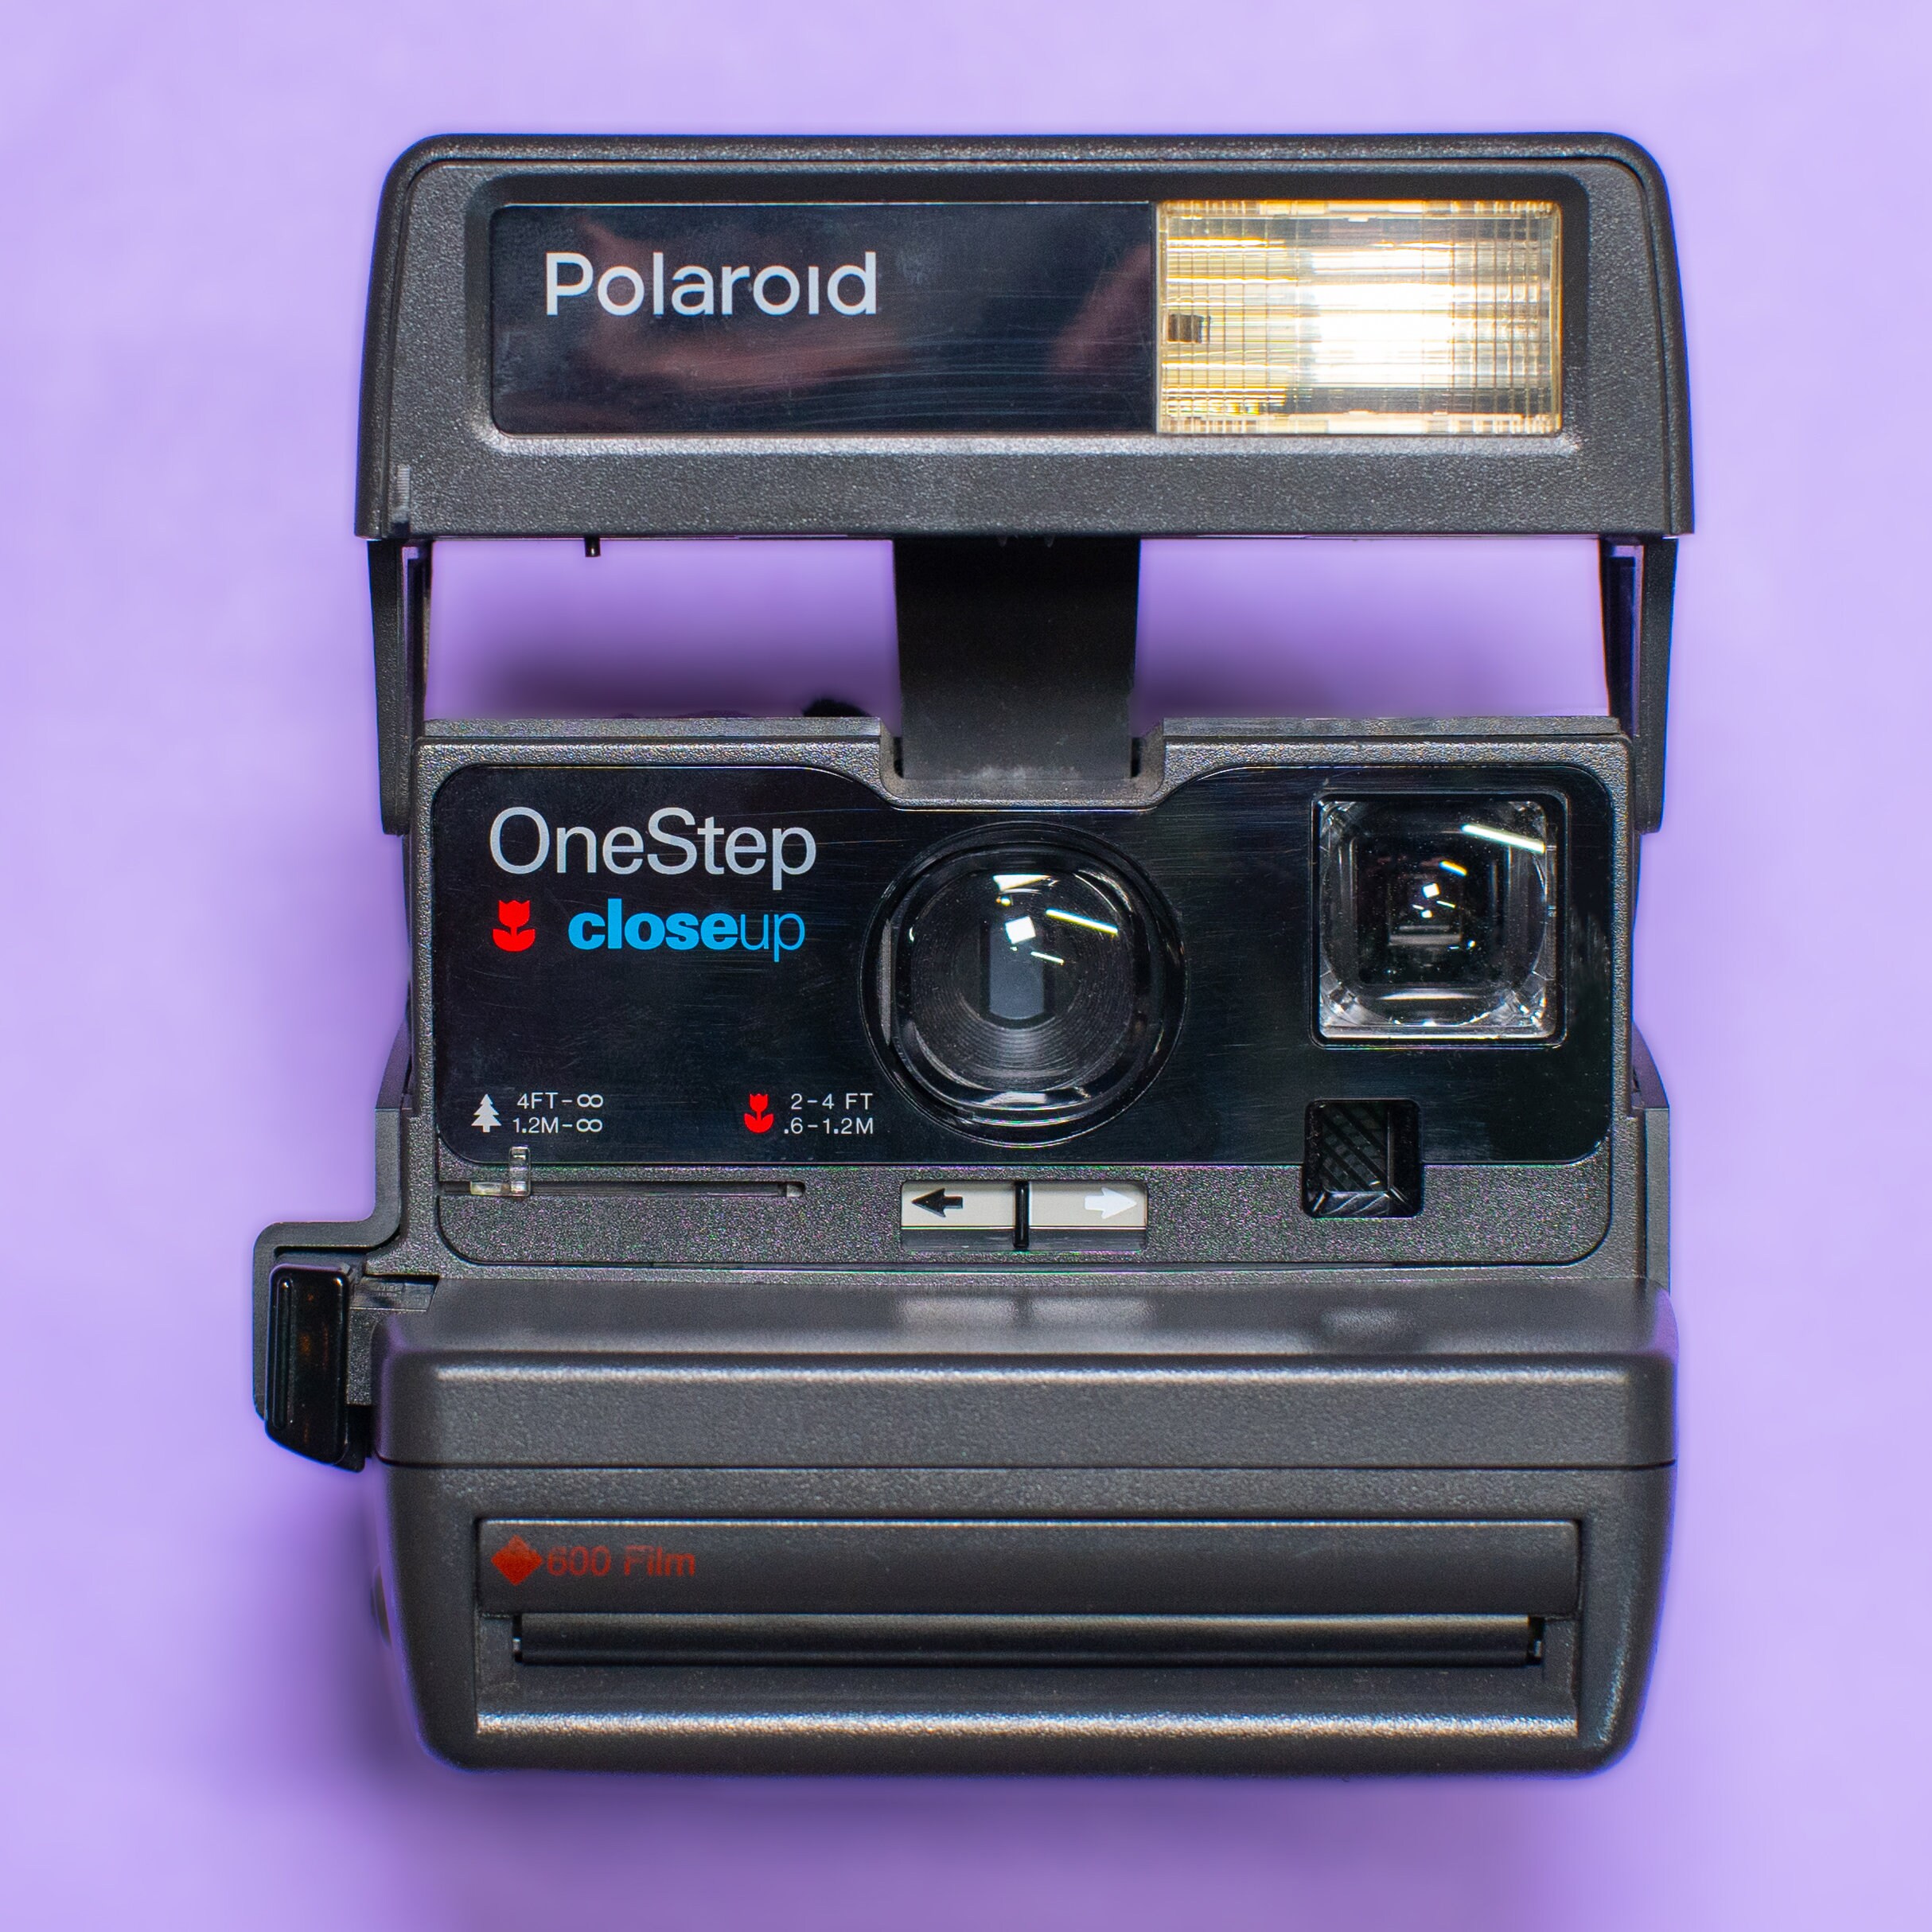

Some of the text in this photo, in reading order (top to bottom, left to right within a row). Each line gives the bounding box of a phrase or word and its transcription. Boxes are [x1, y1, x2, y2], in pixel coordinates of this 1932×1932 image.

[546, 251, 877, 316] Polaroid
[489, 806, 816, 890] OneStep
[567, 897, 806, 963] closeup
[845, 1093, 874, 1110] FT
[546, 1544, 696, 1577] 600 Film
